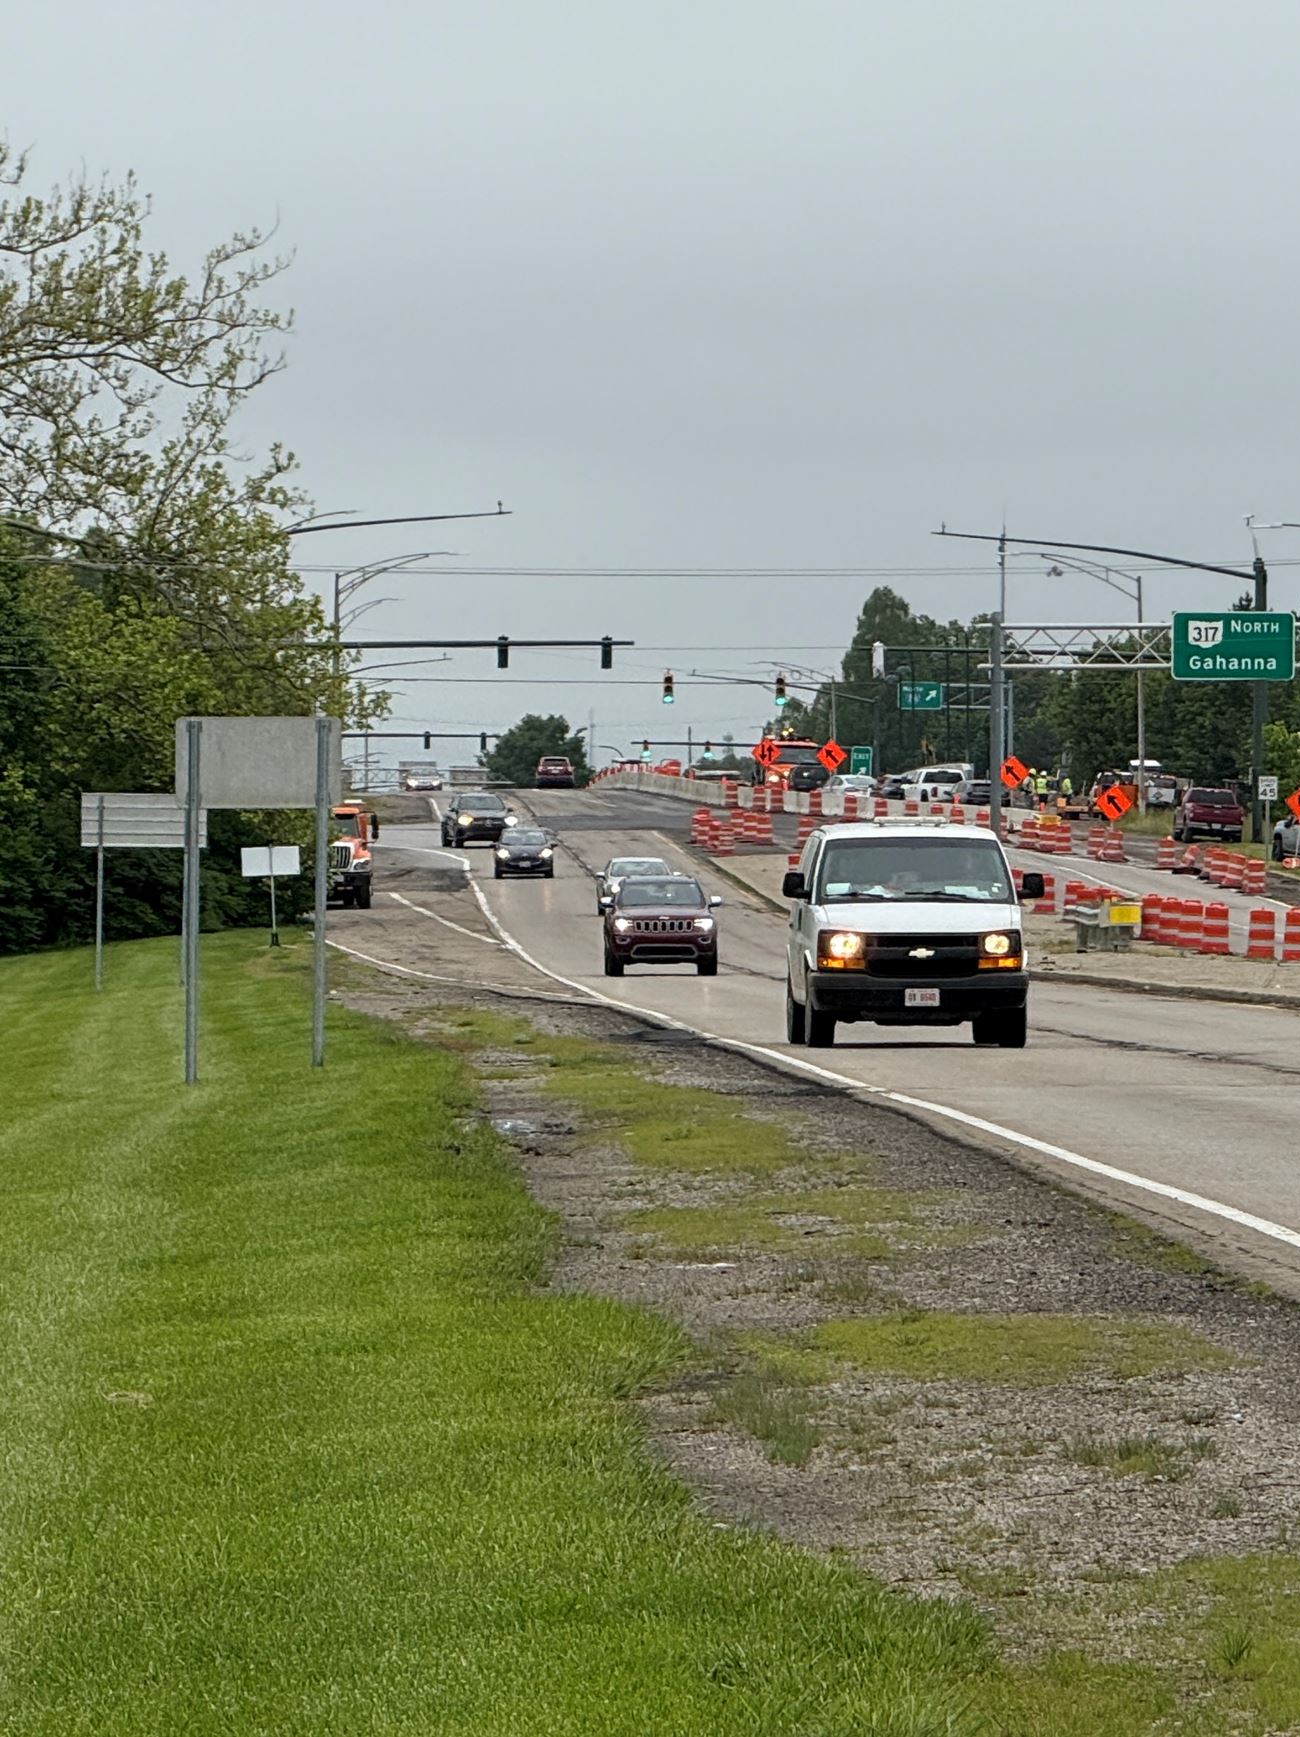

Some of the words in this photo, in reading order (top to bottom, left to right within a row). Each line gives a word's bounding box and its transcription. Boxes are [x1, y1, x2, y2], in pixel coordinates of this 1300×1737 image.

[1192, 626, 1219, 642] 317
[1188, 654, 1277, 670] Gahanna
[1260, 788, 1276, 797] 45
